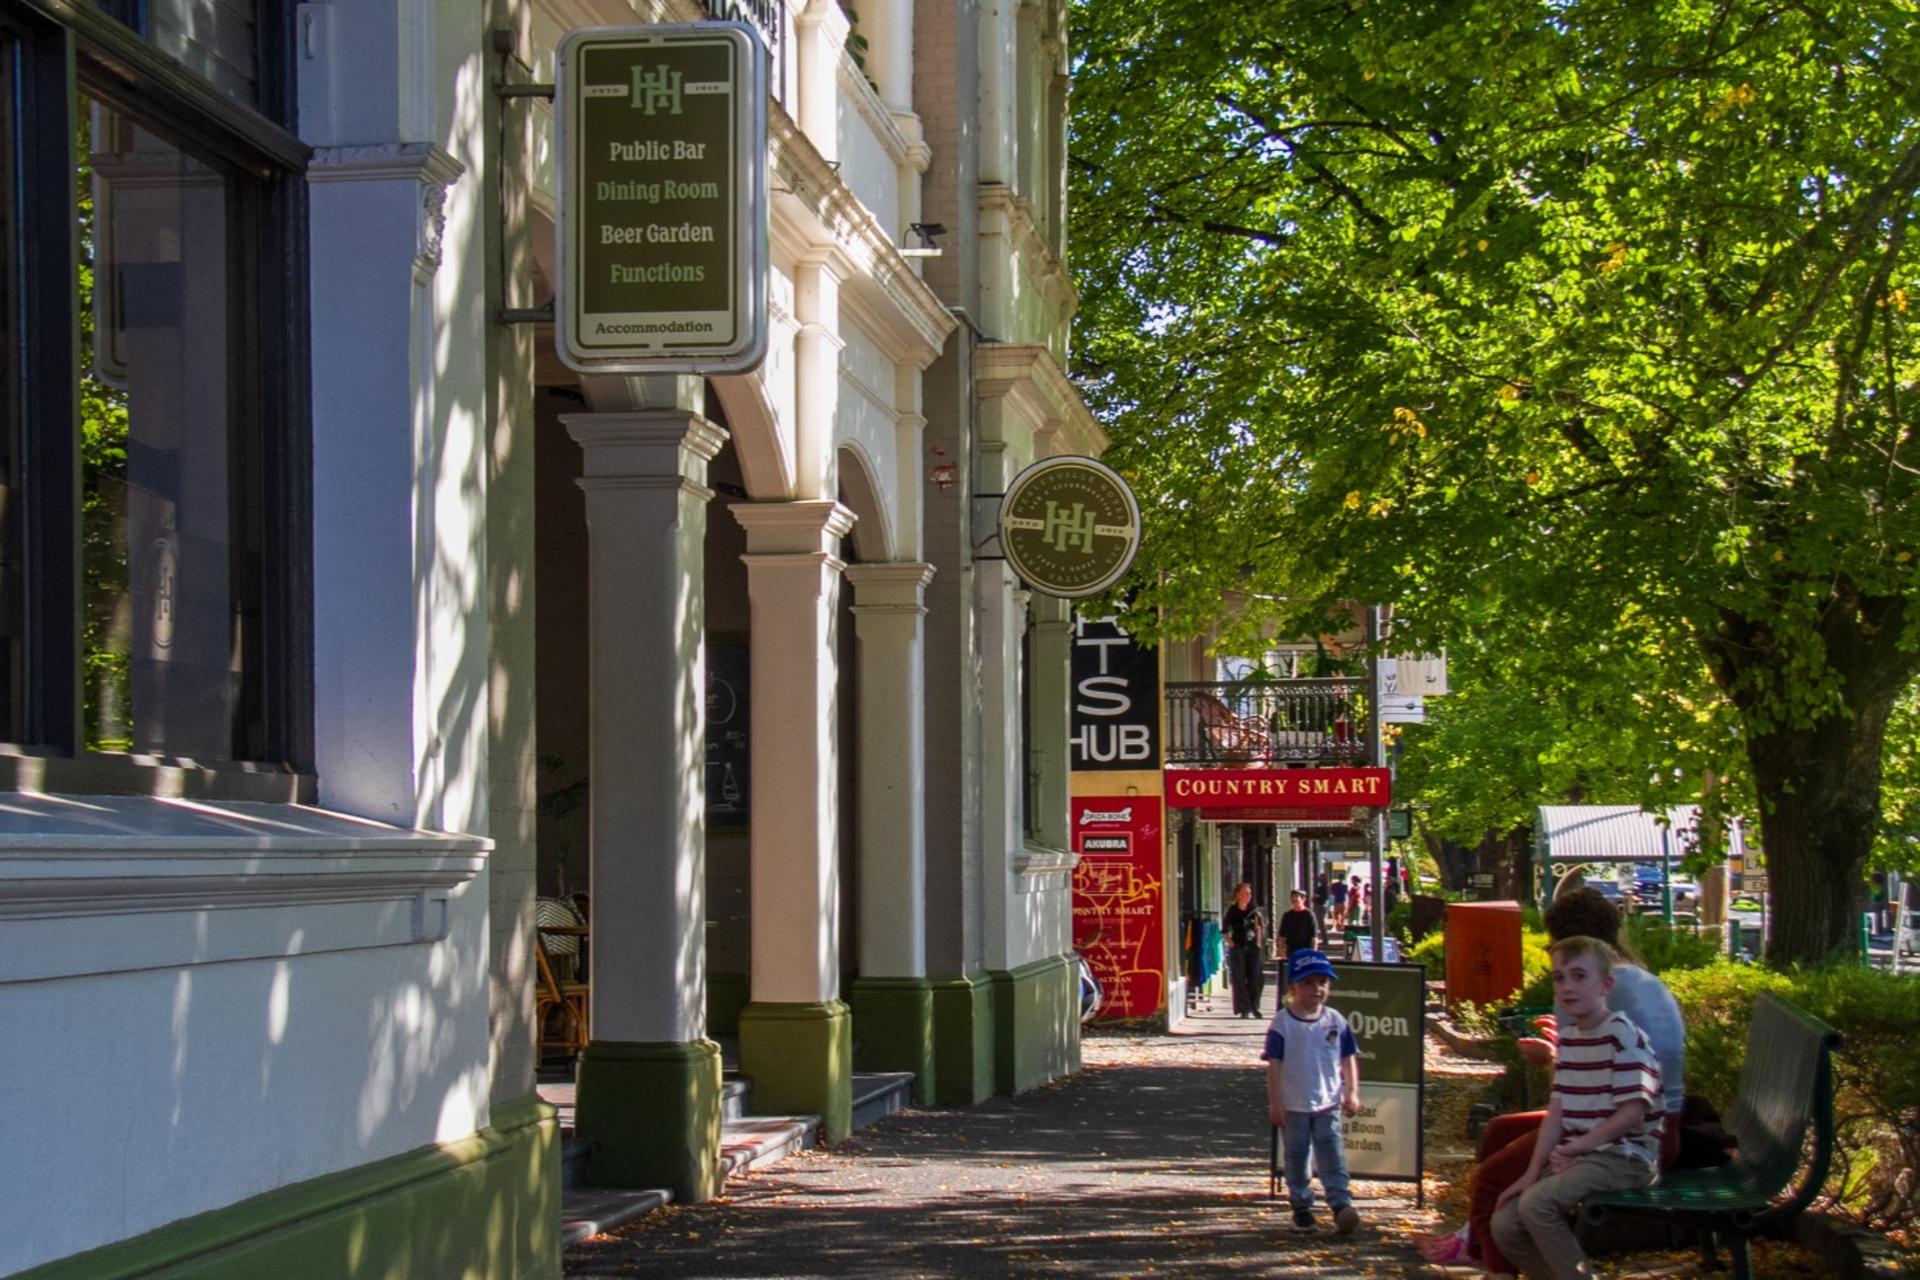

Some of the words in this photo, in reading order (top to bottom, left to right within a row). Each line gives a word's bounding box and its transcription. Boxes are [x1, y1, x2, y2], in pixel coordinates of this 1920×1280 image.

[610, 141, 670, 161] Public
[673, 140, 705, 160] Bar
[597, 181, 660, 203] Dining
[664, 180, 718, 200] Room
[601, 225, 643, 244] Beer
[647, 224, 714, 243] Garden
[610, 263, 705, 283] Functions
[596, 320, 713, 335] Accommodation
[1175, 779, 1288, 796] COUNTRY
[1298, 777, 1381, 795] SMART
[1085, 839, 1127, 849] AKUBRA
[1348, 1011, 1410, 1039] Open
[1351, 1121, 1385, 1135] Room
